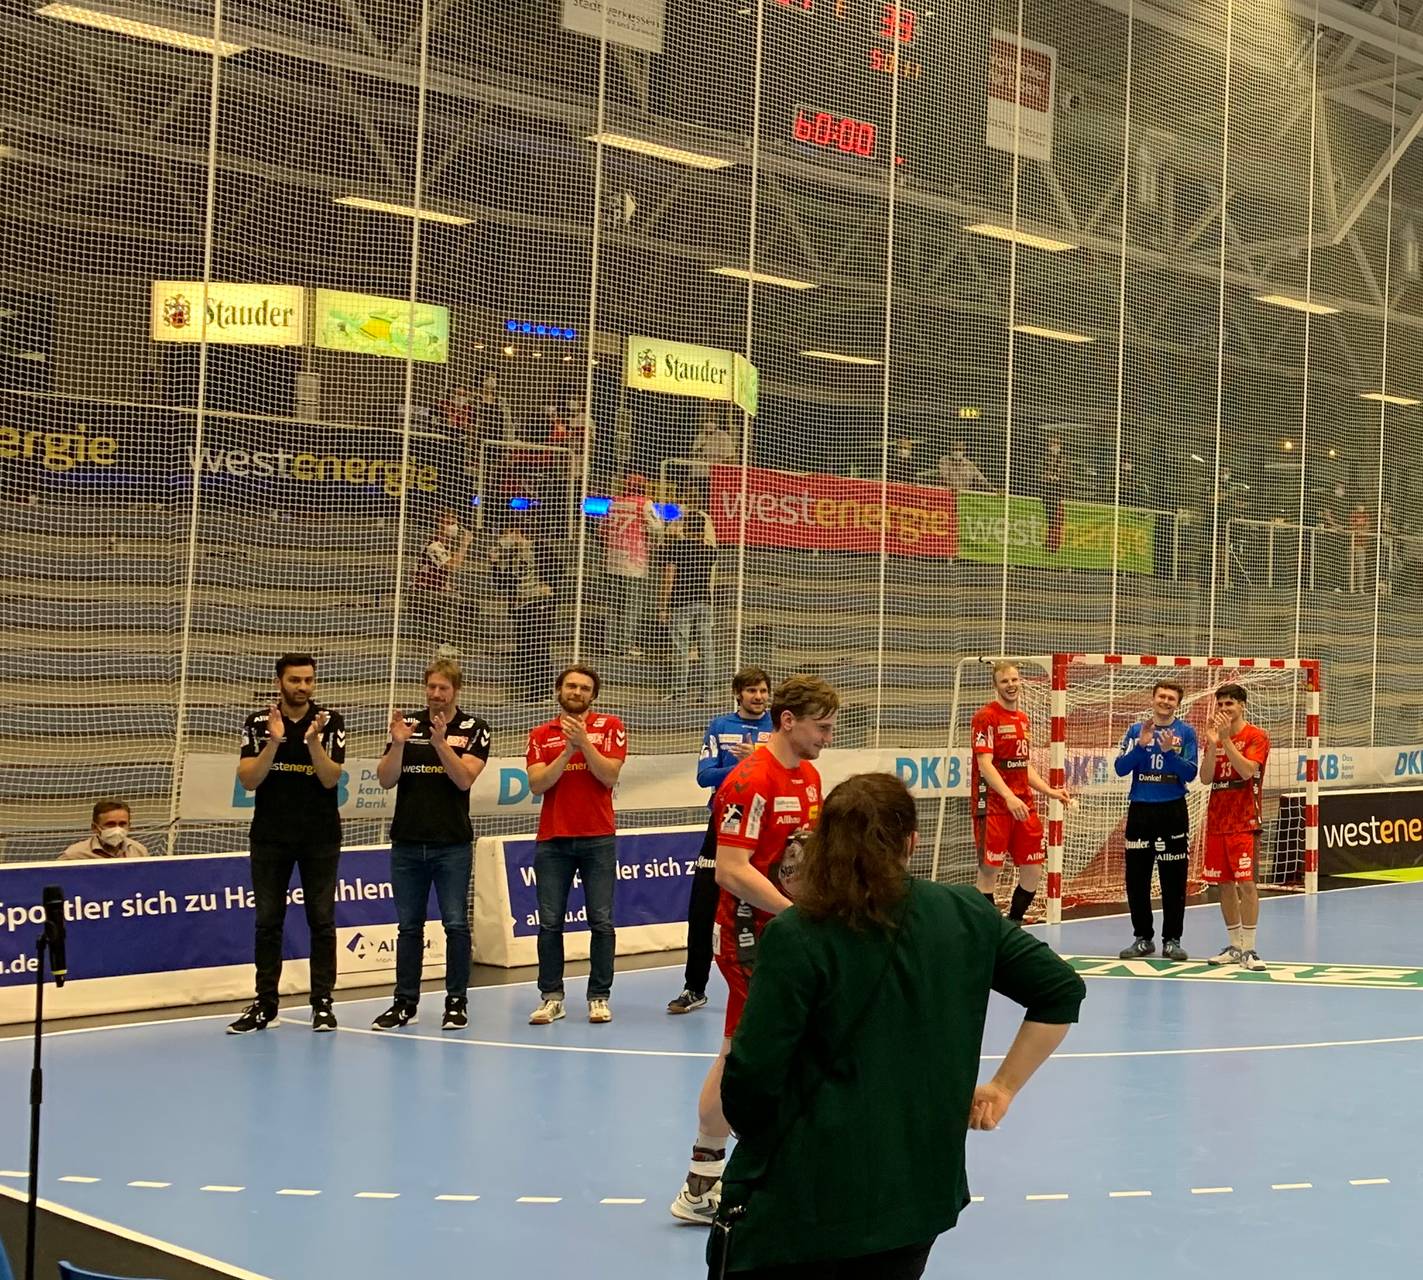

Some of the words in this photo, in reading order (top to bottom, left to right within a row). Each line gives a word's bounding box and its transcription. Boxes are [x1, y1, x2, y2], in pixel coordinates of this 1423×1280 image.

[204, 297, 293, 329] Stauder
[664, 353, 727, 385] Stauder
[0, 425, 117, 471] ergie
[187, 445, 438, 498] westenergie
[721, 489, 950, 545] westenergie
[1016, 740, 1028, 756] 26
[1151, 753, 1164, 769] 16
[402, 764, 447, 773] westene
[895, 756, 961, 789] DKB
[1139, 773, 1162, 782] Danke!
[1296, 754, 1339, 781] DKB
[356, 797, 388, 808] Bank
[645, 856, 681, 877] sich
[1157, 853, 1186, 861] Allbau
[121, 890, 177, 917] sich
[184, 893, 217, 912] zu
[1078, 959, 1420, 987] NRZ
